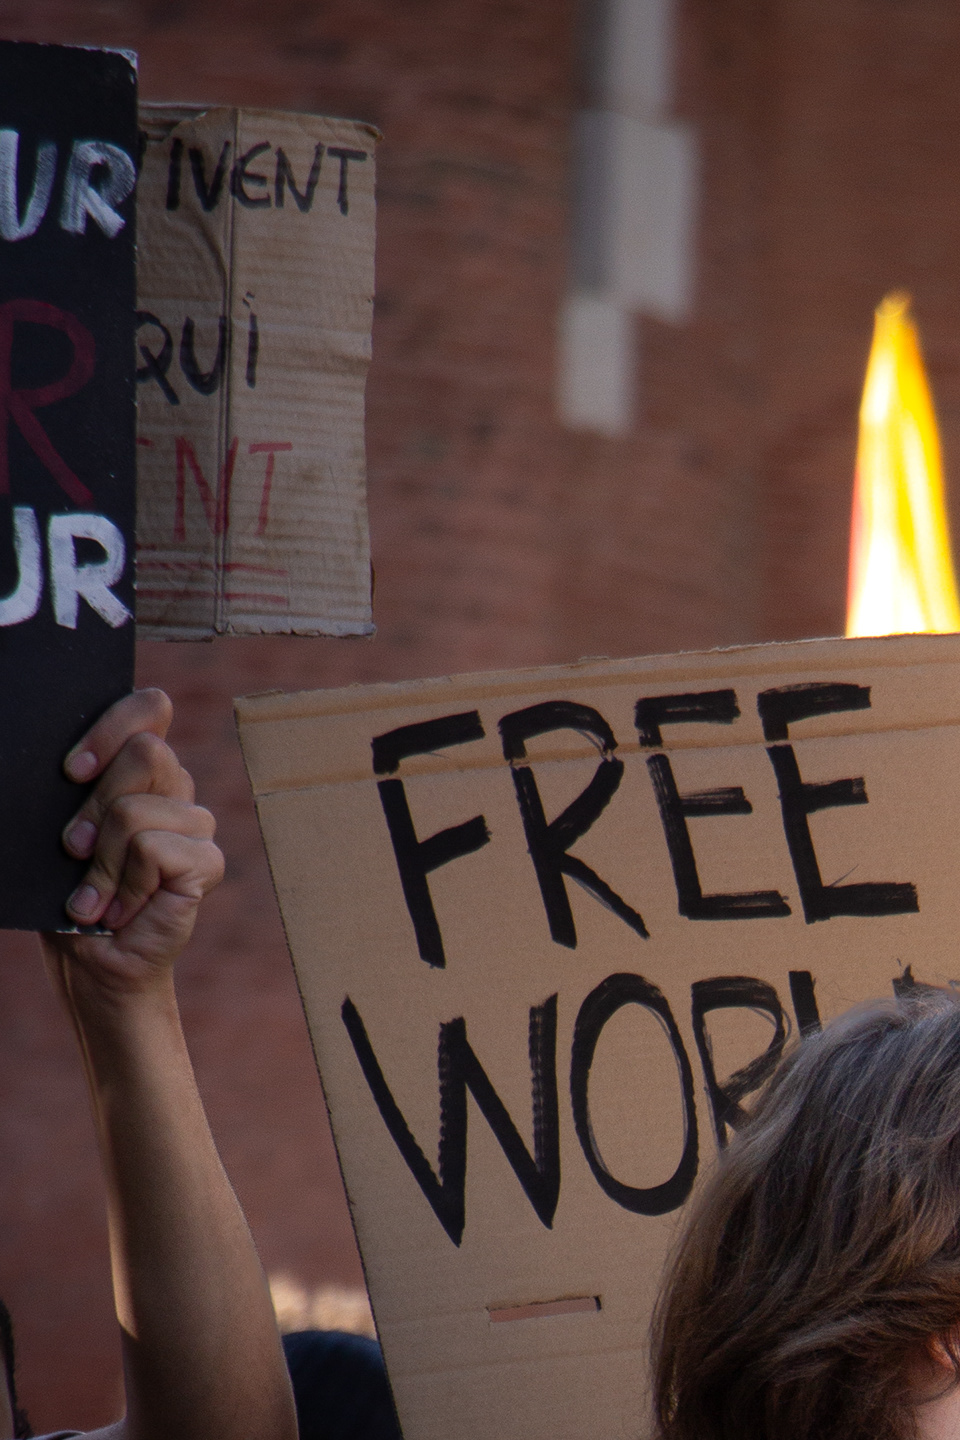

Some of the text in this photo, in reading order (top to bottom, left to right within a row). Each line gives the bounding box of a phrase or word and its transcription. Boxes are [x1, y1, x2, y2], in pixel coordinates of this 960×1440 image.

[137, 131, 367, 216] IVENT
[135, 436, 293, 544] NT
[370, 682, 920, 969] FREE
[340, 963, 955, 1248] WOR
